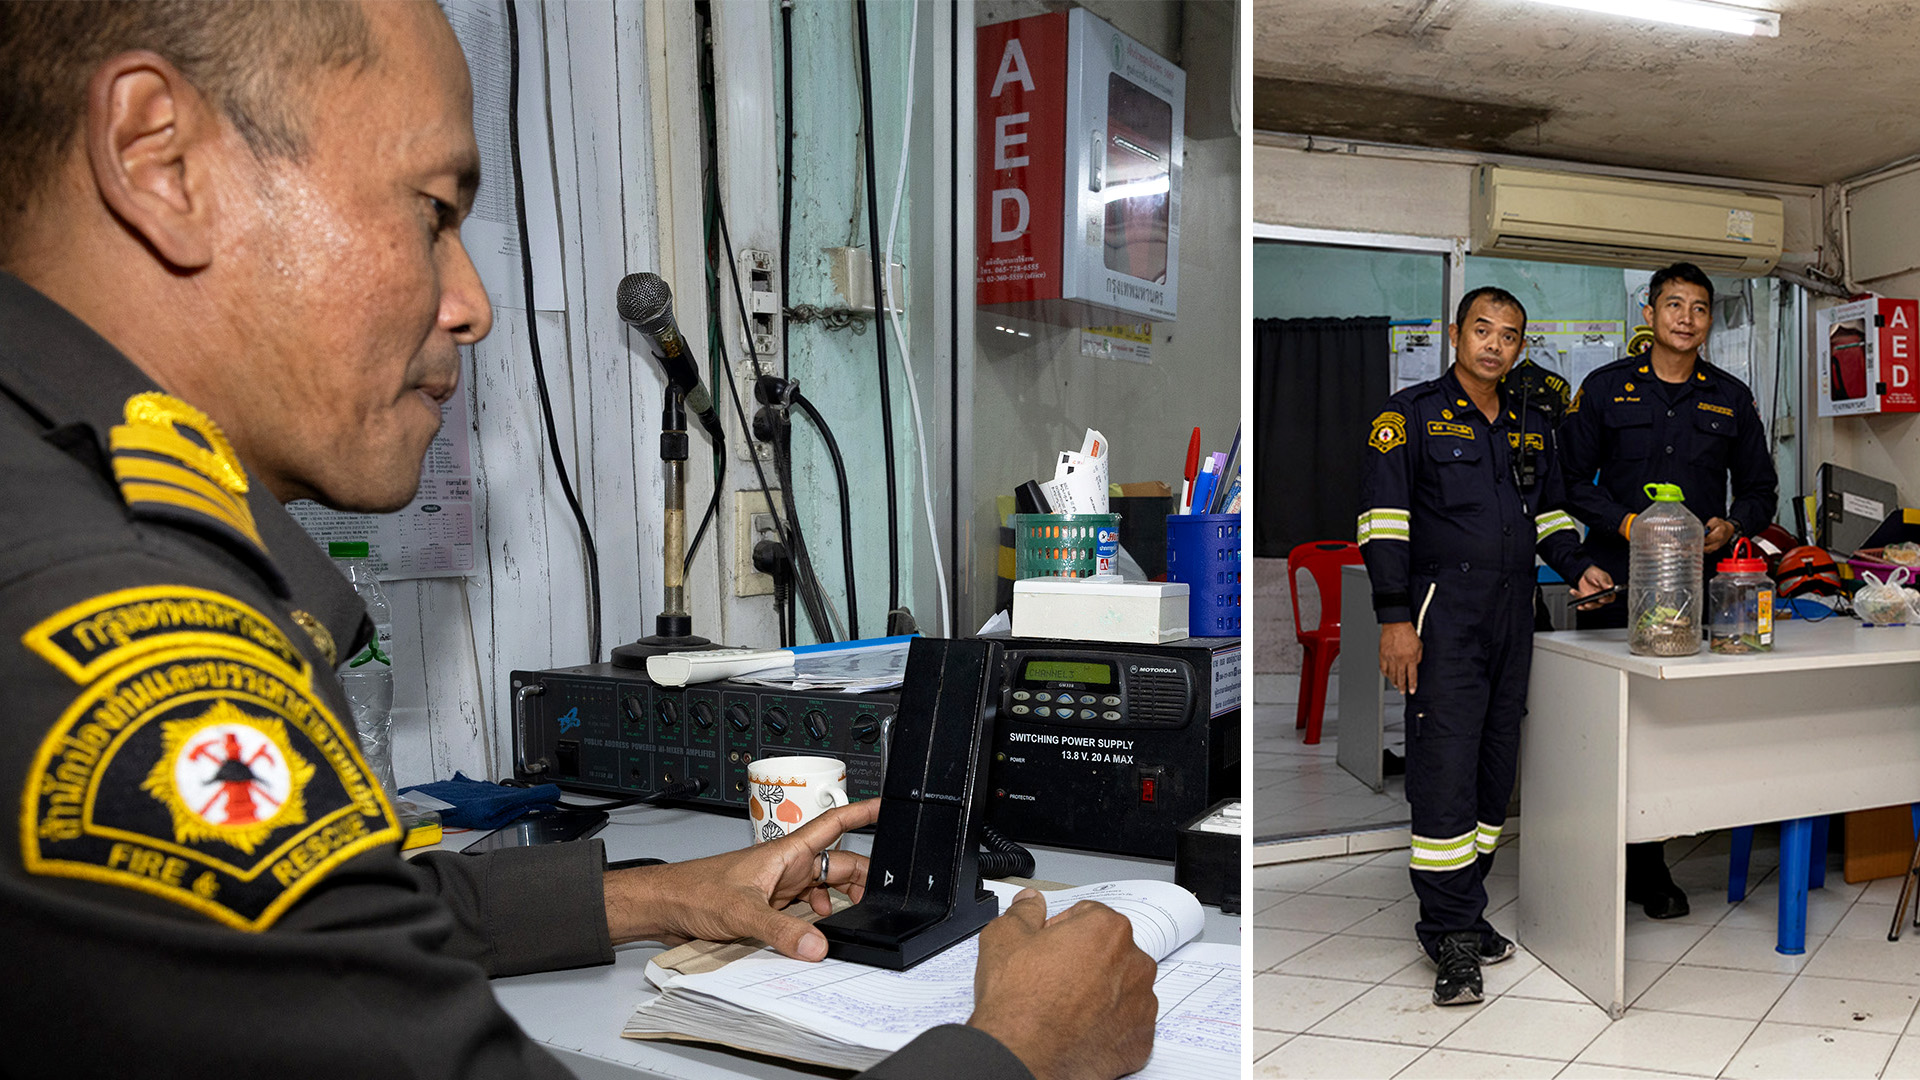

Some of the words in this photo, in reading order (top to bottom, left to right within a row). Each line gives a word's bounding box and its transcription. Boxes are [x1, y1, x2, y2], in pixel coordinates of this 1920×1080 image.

[990, 38, 1036, 244] AED
[1889, 305, 1909, 388] AED
[1139, 666, 1178, 674] MOTOROLA
[583, 737, 603, 747] PUBLIC
[604, 739, 630, 750] ADDRESS
[631, 742, 656, 752] POWERED
[685, 746, 716, 758] AMPLIFIER
[1009, 732, 1060, 746] SWITCHING
[1061, 736, 1096, 748] POWER
[1097, 738, 1135, 751] SUPPLY
[1061, 750, 1080, 761] 13.8
[1081, 751, 1090, 762] V.
[1091, 752, 1102, 762] 20
[1103, 753, 1111, 763] A
[1112, 754, 1135, 765] MAX
[924, 792, 962, 802] MOTOROLA
[1009, 793, 1036, 802] PROTECTION
[107, 842, 190, 887] FIRE
[271, 811, 371, 890] RESCUE
